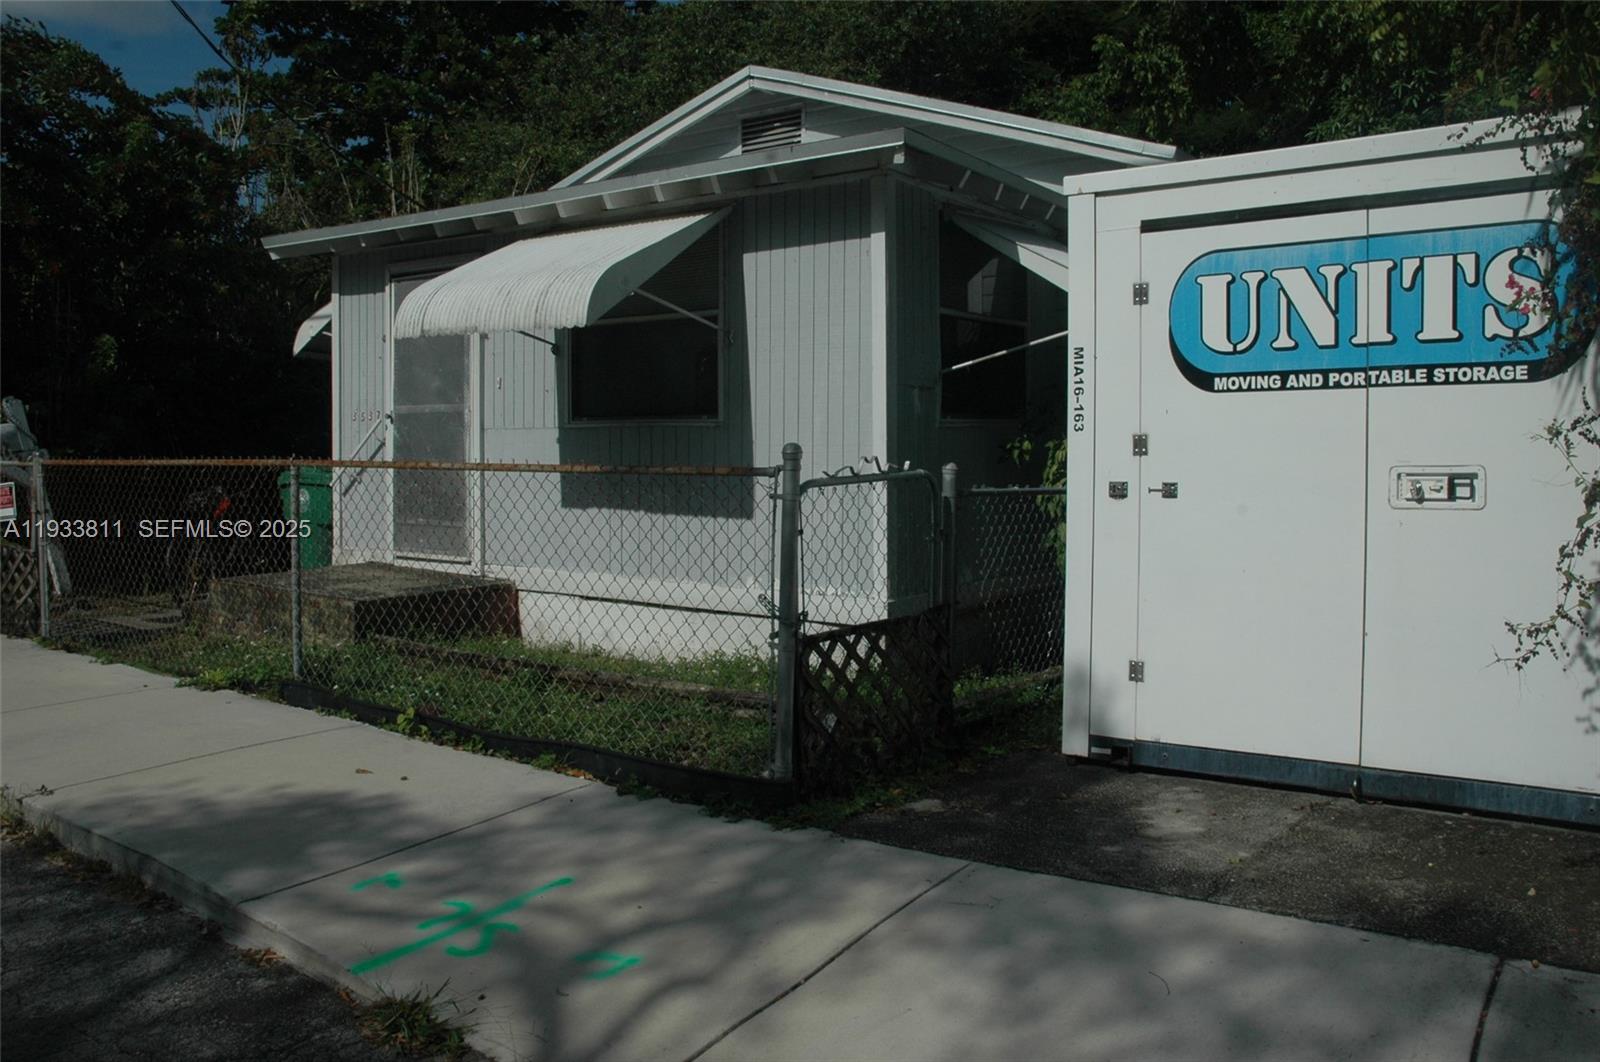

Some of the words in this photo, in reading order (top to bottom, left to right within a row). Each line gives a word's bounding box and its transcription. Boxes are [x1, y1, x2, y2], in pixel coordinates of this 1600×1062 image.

[1195, 246, 1557, 355] UNITS
[1073, 346, 1085, 432] MIA16-163
[1213, 376, 1282, 391] MOVING
[1286, 373, 1324, 388] AND
[1328, 370, 1428, 386] PORTABLE
[1433, 364, 1529, 382] STORAGE
